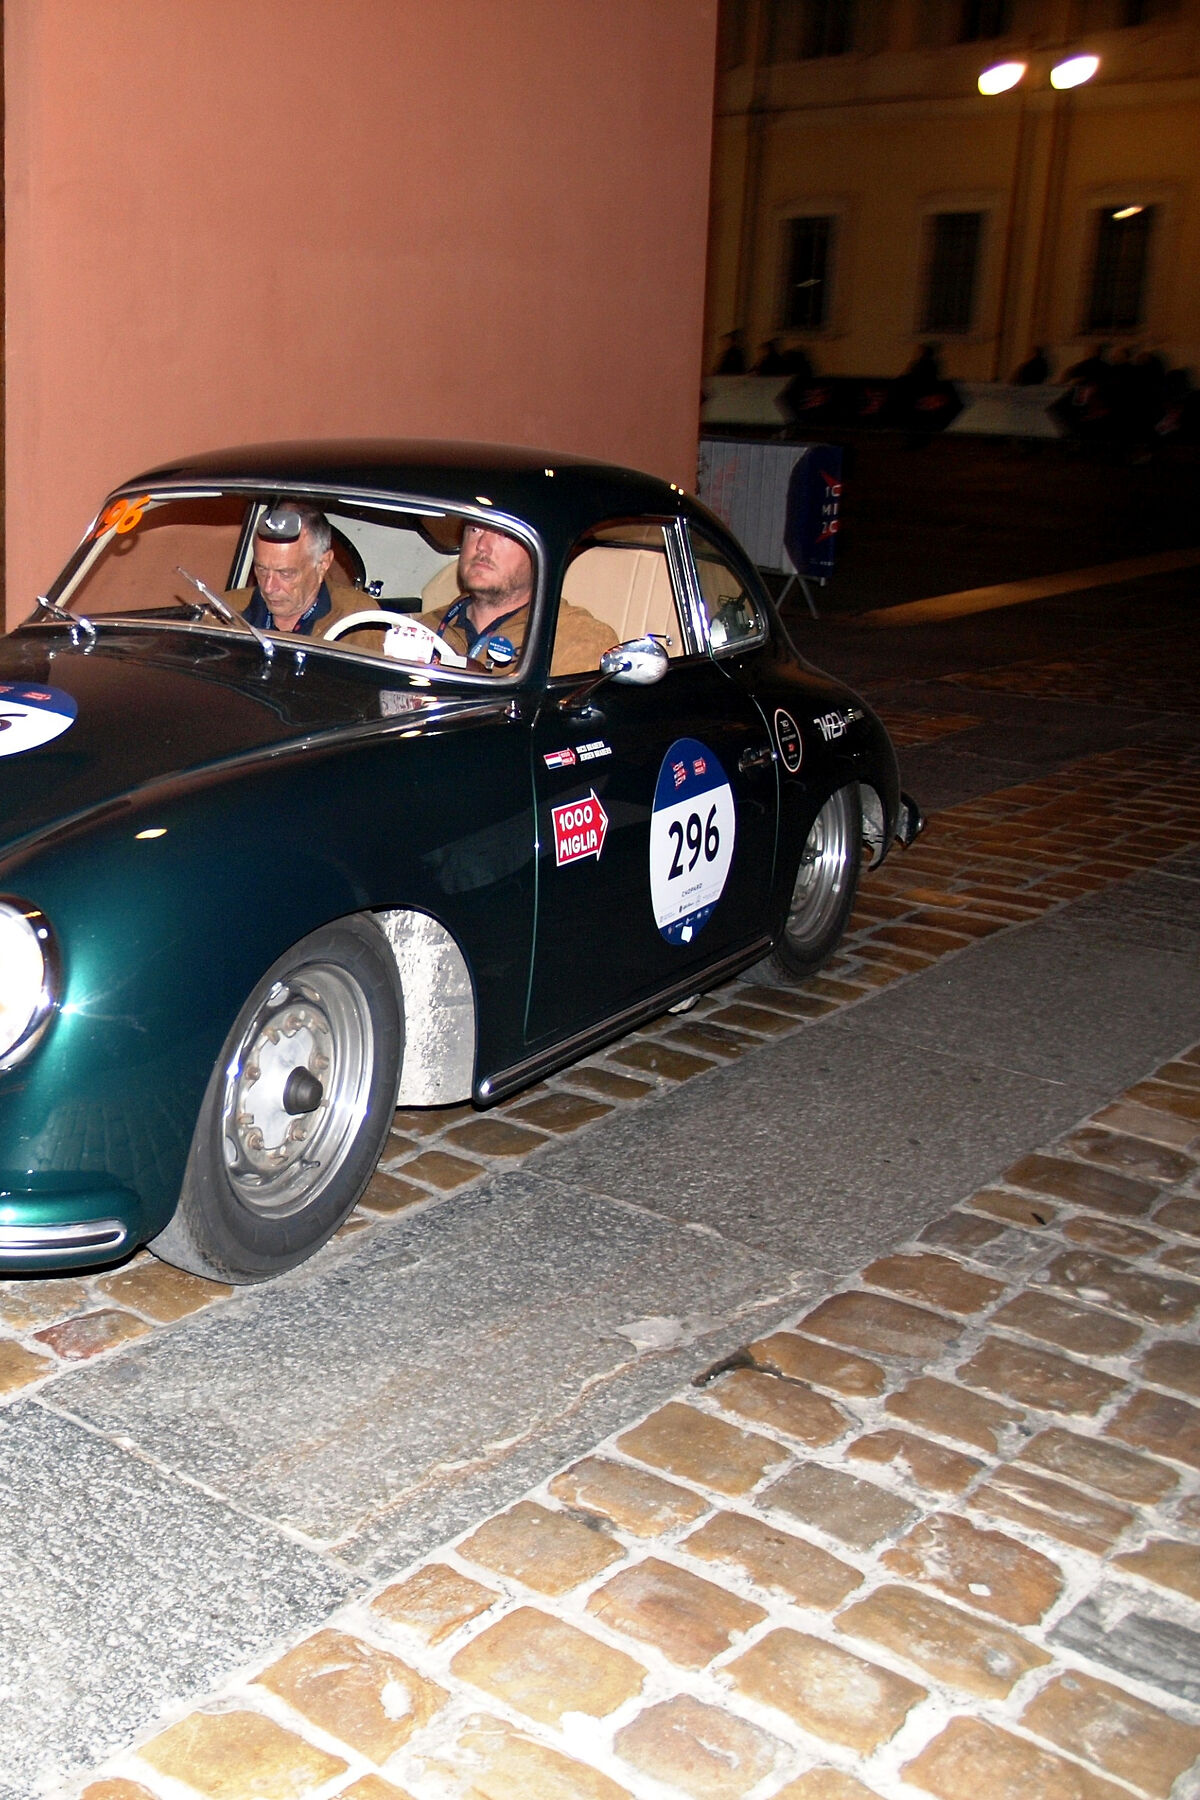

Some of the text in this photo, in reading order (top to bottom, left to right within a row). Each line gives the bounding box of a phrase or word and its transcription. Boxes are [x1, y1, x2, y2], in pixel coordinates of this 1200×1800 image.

[559, 805, 593, 831] 1000
[560, 829, 598, 858] MIGLIA
[668, 804, 720, 880] 296
